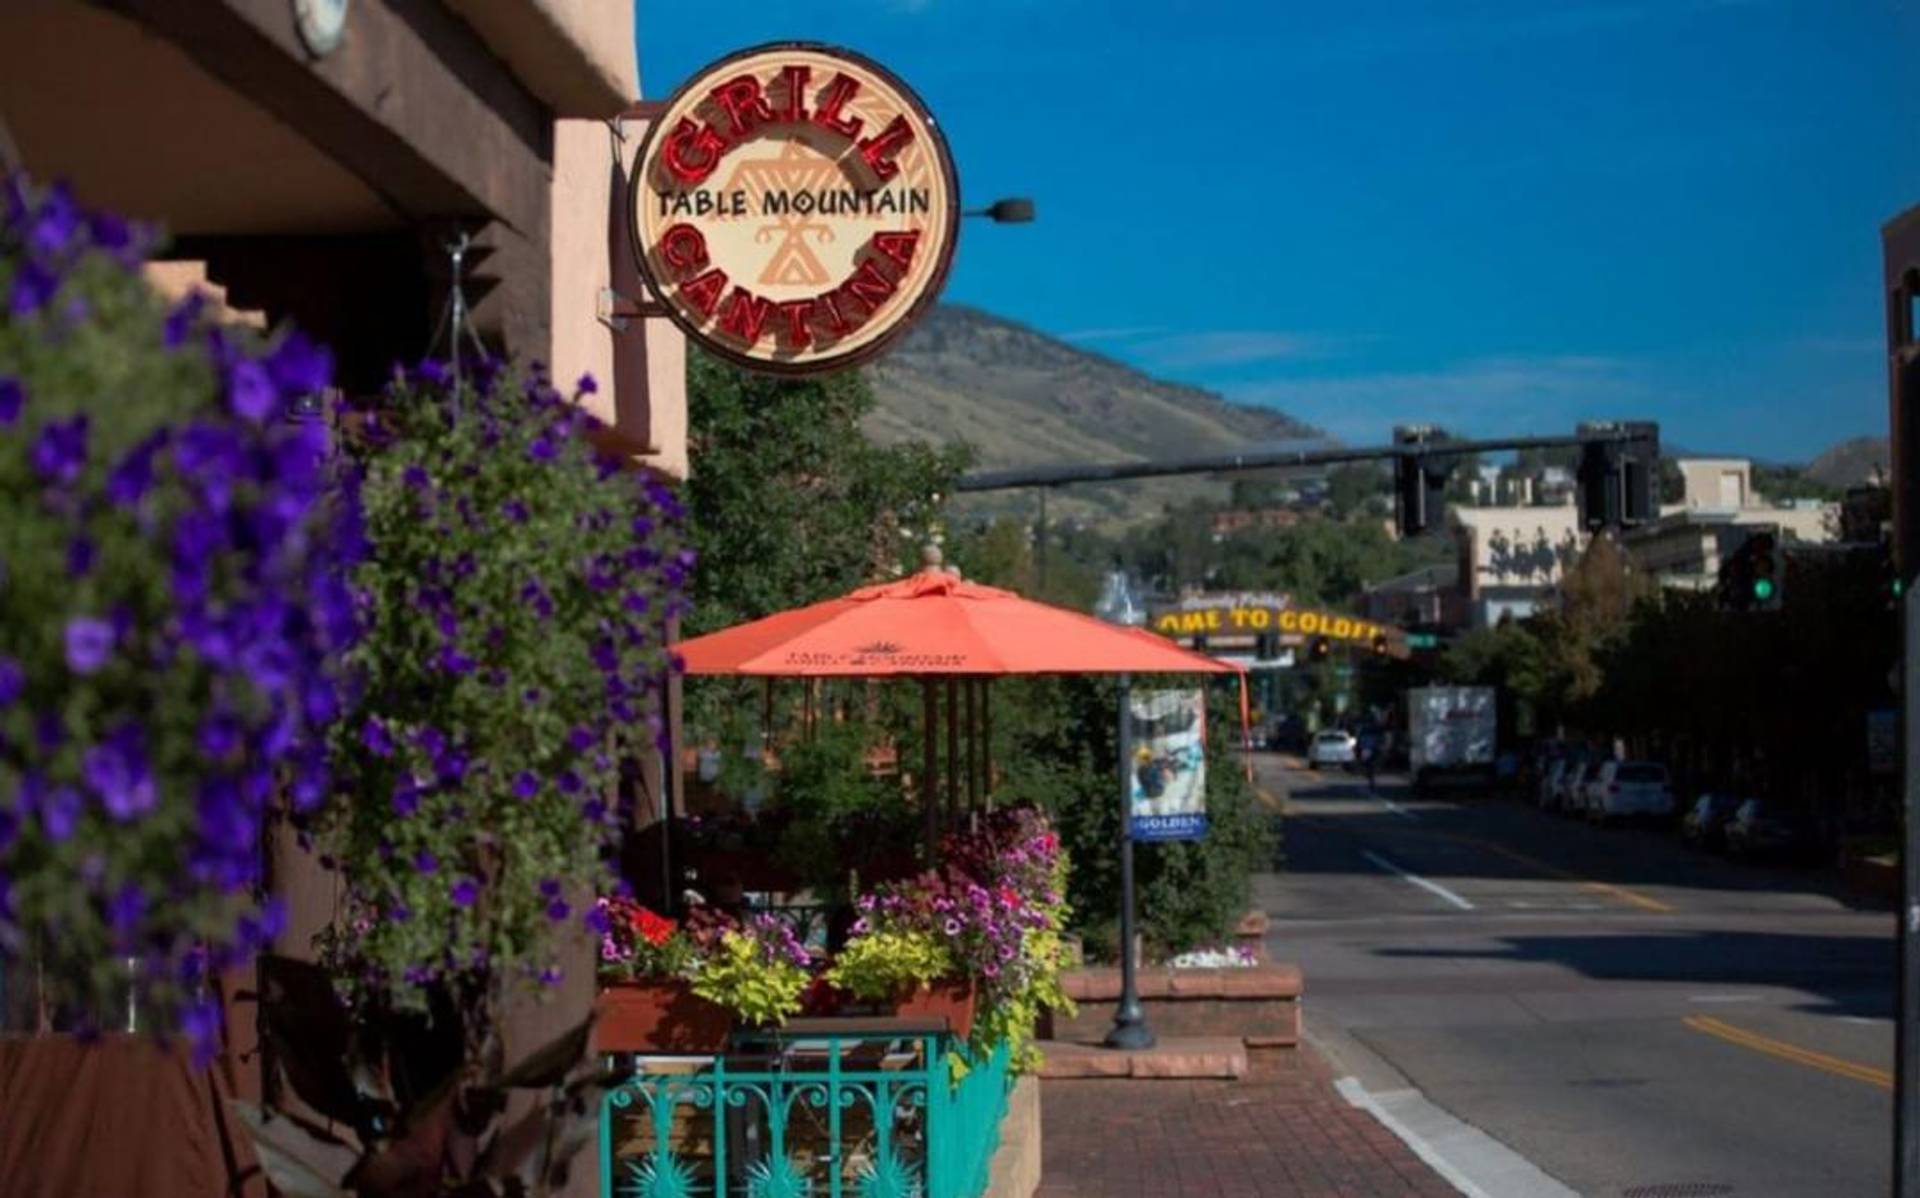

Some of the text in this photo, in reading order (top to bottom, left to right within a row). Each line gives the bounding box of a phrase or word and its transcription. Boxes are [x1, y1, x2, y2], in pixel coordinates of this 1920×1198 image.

[663, 65, 916, 184] GRILL
[657, 187, 930, 217] TABLE MOUNTAIN
[659, 224, 921, 348] CANTINA
[1157, 609, 1221, 633] OME
[1231, 607, 1270, 629] TO
